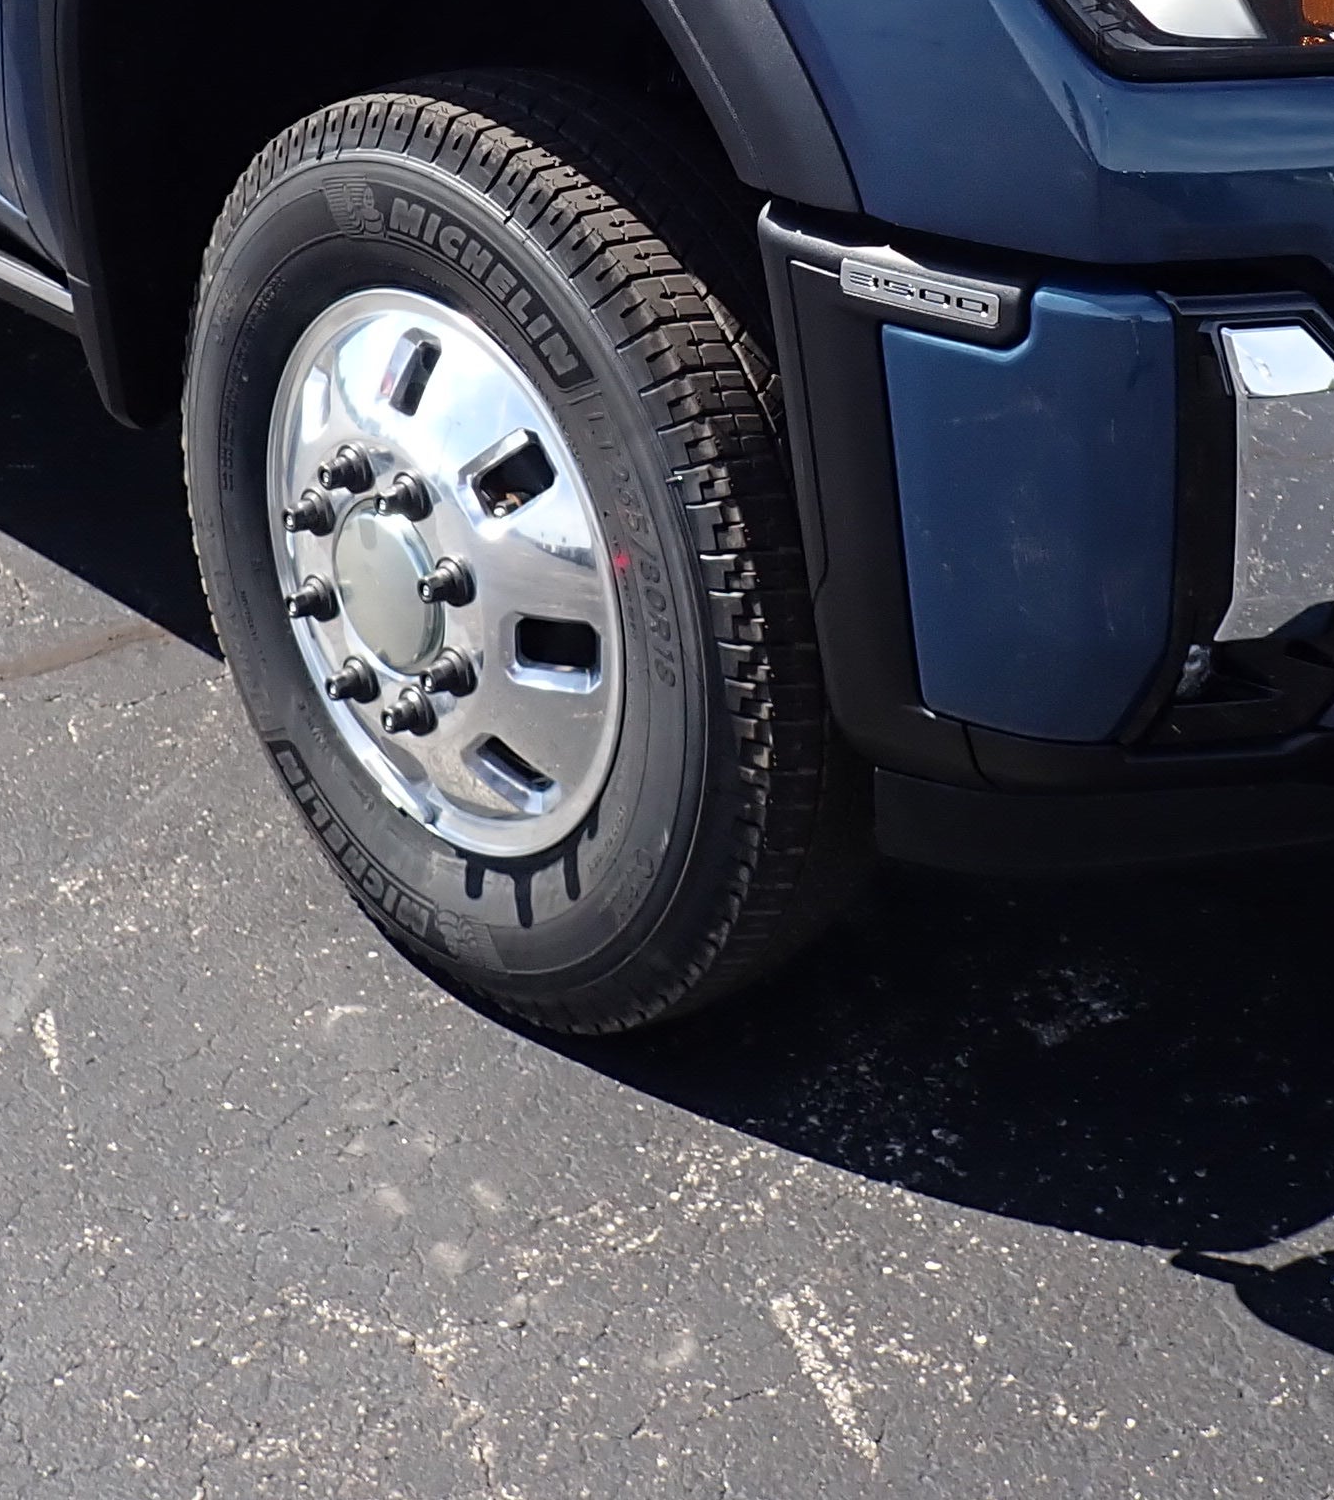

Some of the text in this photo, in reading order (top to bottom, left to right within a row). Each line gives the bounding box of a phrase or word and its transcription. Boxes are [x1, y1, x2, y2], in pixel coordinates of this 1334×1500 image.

[389, 197, 579, 376] MICHELIN
[849, 269, 990, 318] 3500
[277, 751, 430, 938] MICHELIN
